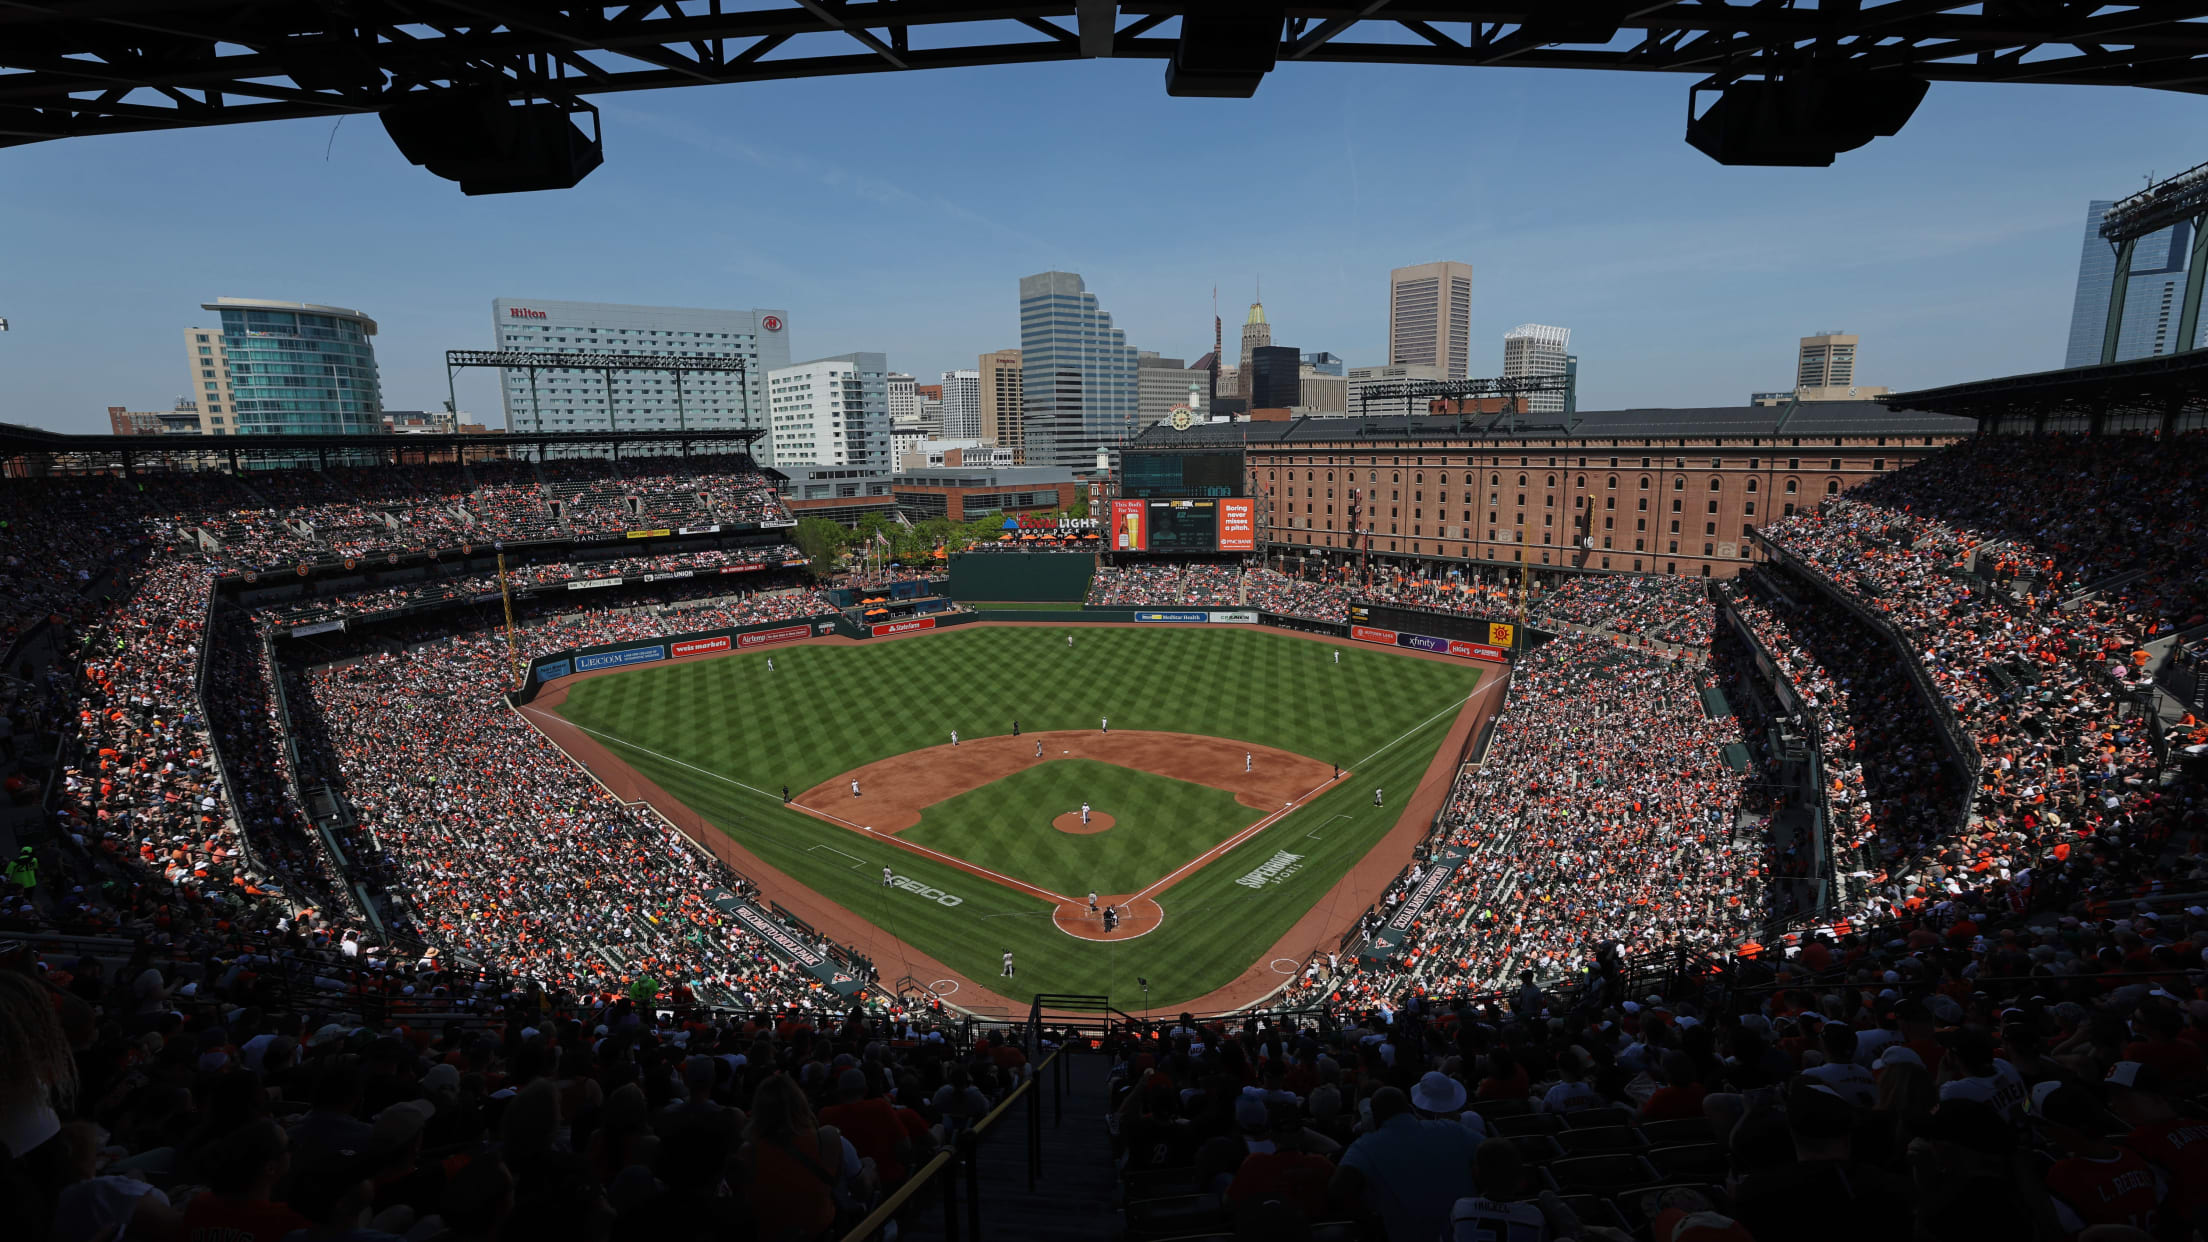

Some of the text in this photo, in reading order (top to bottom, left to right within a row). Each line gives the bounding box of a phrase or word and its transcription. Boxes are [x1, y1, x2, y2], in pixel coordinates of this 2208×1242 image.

[510, 307, 546, 320] Hilton
[1019, 513, 1097, 528] Coors LIGHT
[573, 534, 600, 543] GANZ
[673, 570, 693, 578] UNION
[695, 640, 726, 650] markets
[743, 634, 765, 643] Airtemp
[1409, 636, 1435, 650] xfinity
[1235, 849, 1305, 888] SUPERBOOK
[1270, 864, 1303, 884] SPORTS
[890, 875, 963, 906] GEICO
[796, 949, 821, 966] PARK
